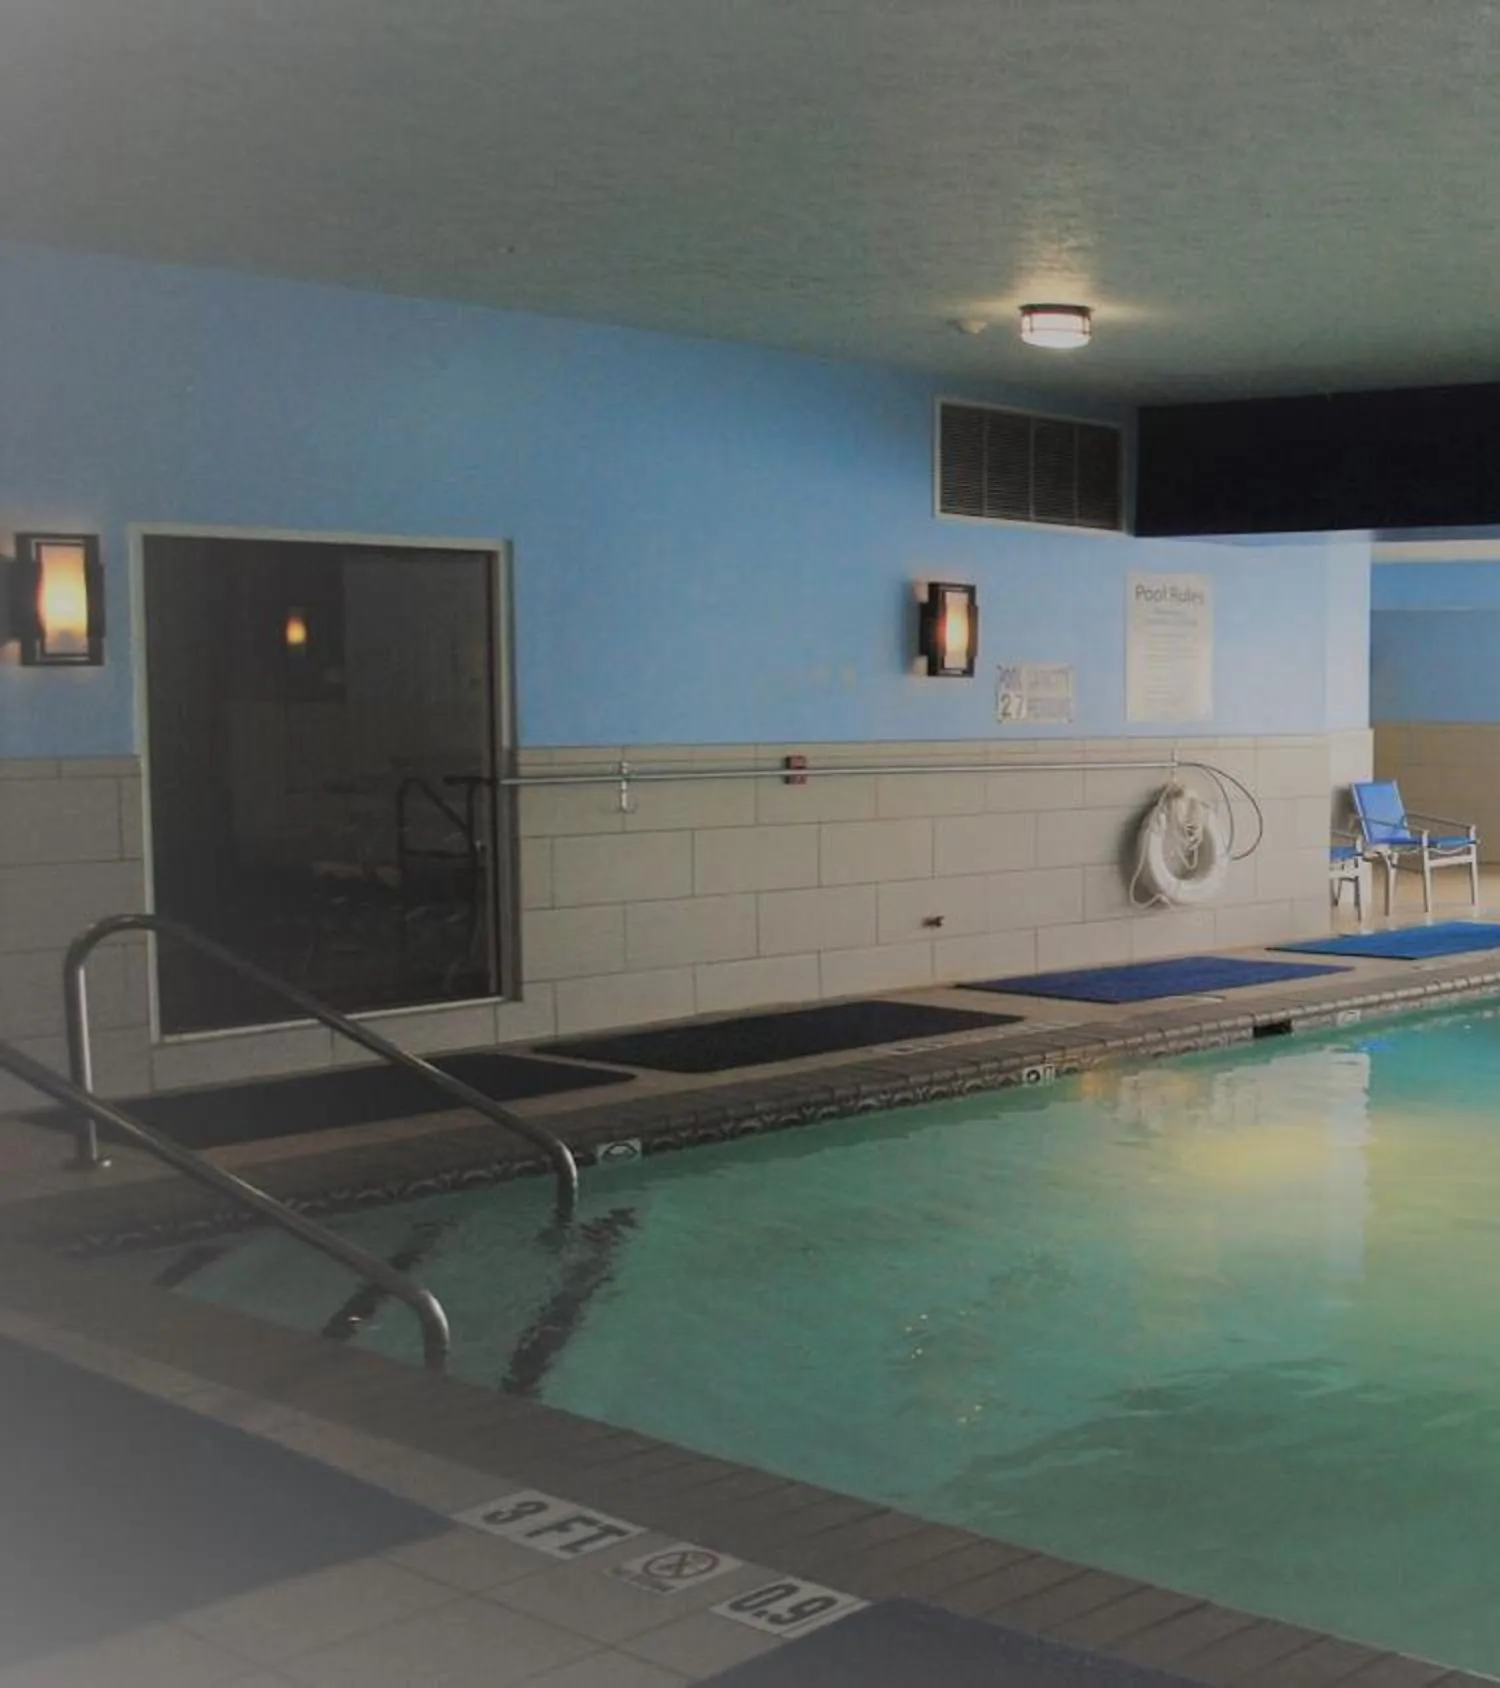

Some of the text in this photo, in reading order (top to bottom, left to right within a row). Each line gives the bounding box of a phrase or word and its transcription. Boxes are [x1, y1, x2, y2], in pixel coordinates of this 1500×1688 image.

[1135, 584, 1167, 602] Pool
[1000, 693, 1025, 719] 27
[482, 1500, 633, 1554] 3 FT
[728, 1583, 838, 1626] 0.9
